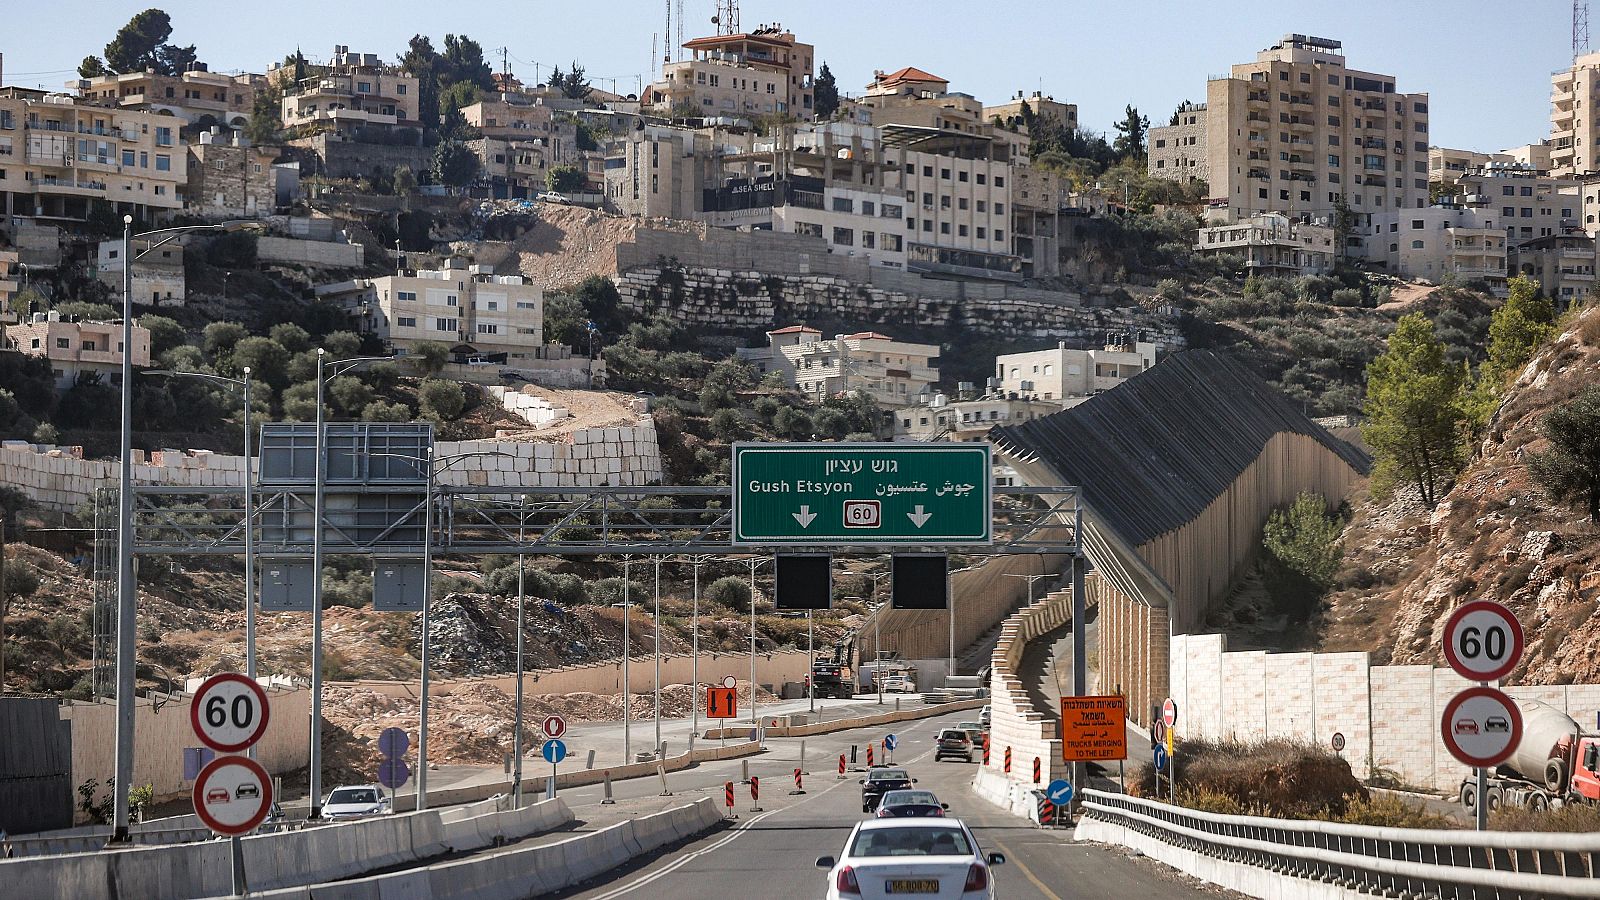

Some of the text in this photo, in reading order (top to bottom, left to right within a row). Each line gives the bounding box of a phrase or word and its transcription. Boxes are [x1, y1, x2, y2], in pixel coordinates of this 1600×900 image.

[738, 183, 775, 193] SEA SHELL
[825, 459, 898, 476] גוש עציון
[749, 480, 853, 496] Gush Etsyon
[875, 481, 928, 497] عتسيون
[852, 508, 872, 520] 60
[1460, 625, 1506, 661] 60
[205, 694, 253, 729] 60
[1075, 749, 1114, 757] TO THE LEFT
